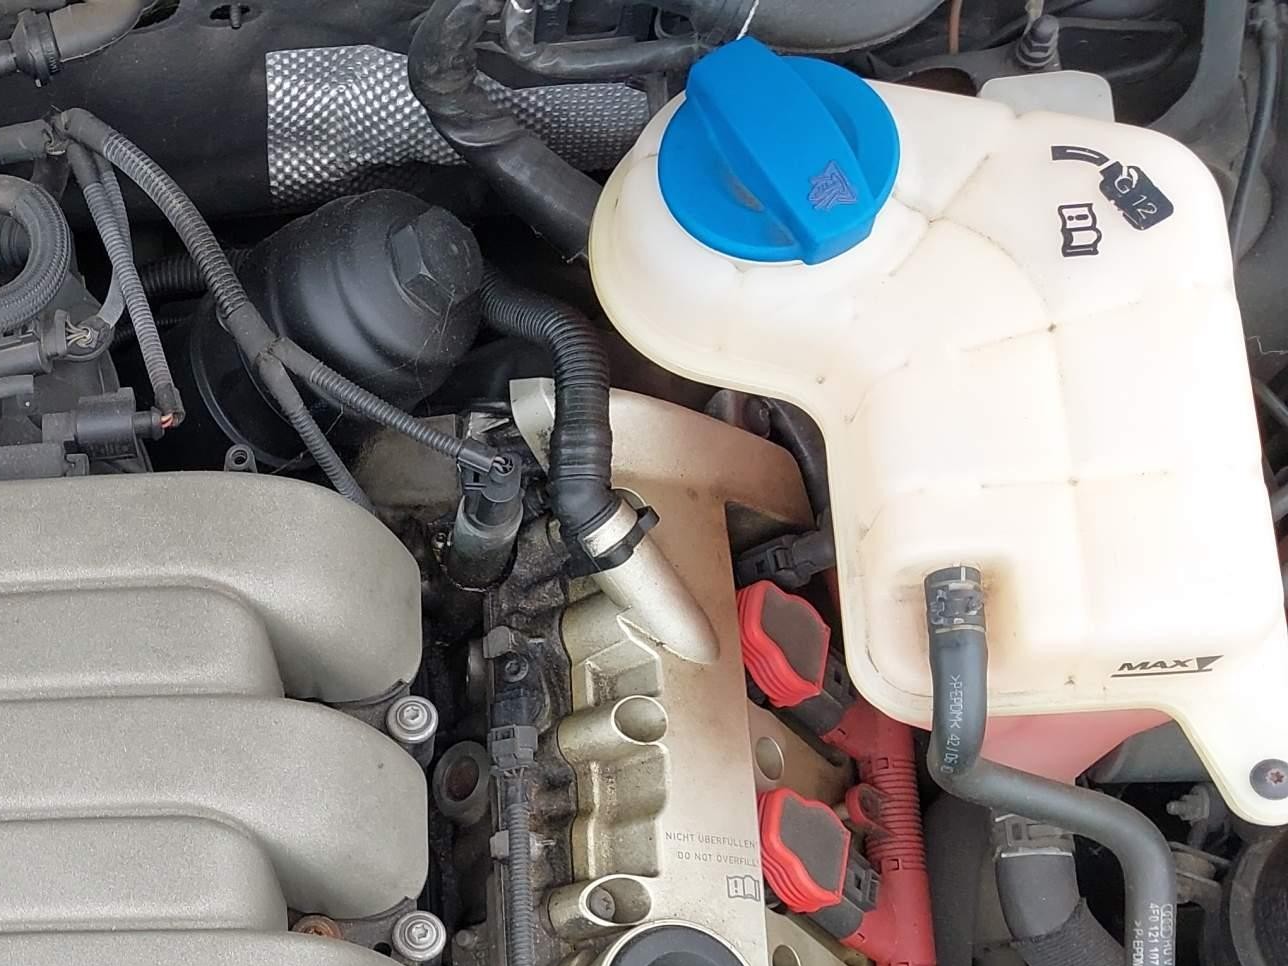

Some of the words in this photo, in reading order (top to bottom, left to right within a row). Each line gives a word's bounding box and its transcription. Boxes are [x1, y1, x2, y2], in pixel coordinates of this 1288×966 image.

[1114, 175, 1130, 194] G
[1132, 195, 1158, 220] 12
[1117, 658, 1193, 671] MAX
[665, 831, 694, 841] NICHT
[677, 851, 691, 860] DO
[694, 852, 712, 862] NOT
[1148, 924, 1159, 943] 121
[1148, 946, 1159, 965] 107
